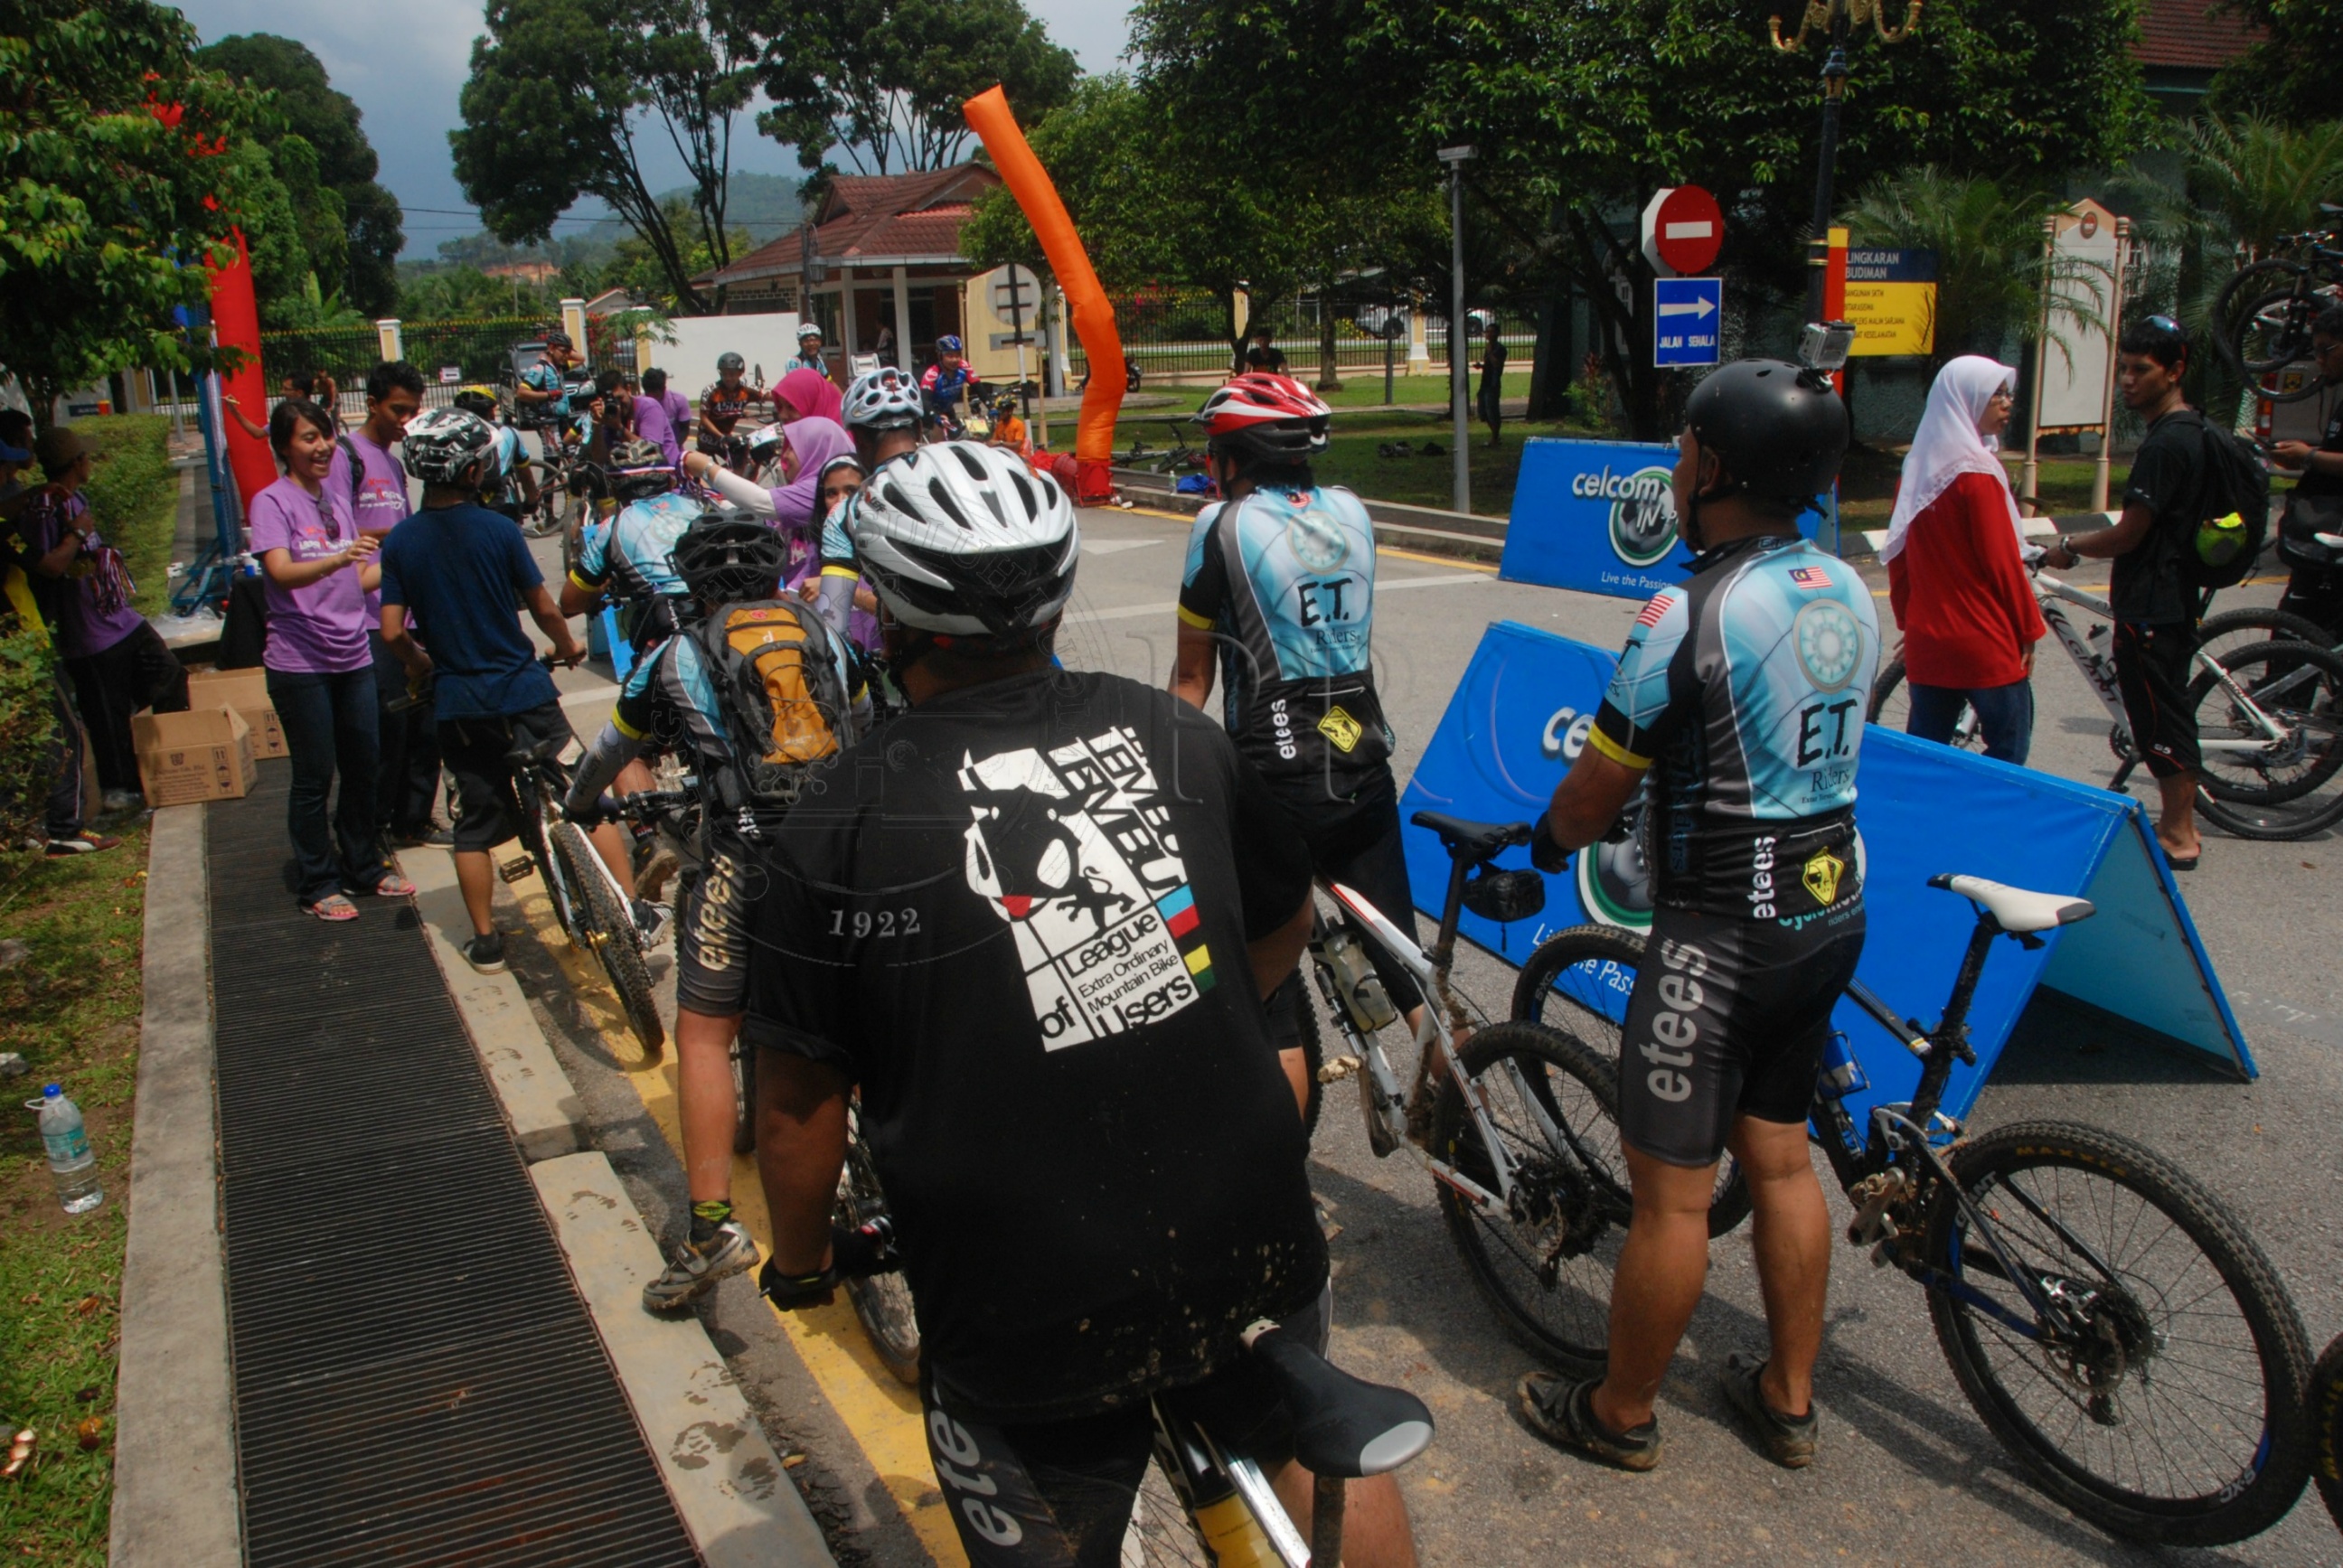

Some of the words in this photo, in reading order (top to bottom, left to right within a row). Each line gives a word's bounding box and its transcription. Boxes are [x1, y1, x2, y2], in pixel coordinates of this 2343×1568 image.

[1845, 252, 1899, 265] LINGKARAN
[1845, 268, 1887, 278] BUDIMAN
[1659, 335, 1683, 349] JALAN
[1688, 334, 1716, 347] SEHALA
[1571, 465, 1661, 501] celcom
[1601, 570, 1620, 584] Live
[1622, 573, 1637, 587] the
[1639, 576, 1672, 589] Passion
[1271, 699, 1297, 759] etees
[1746, 835, 1777, 919] etees
[1060, 913, 1159, 979] League
[1077, 972, 1115, 999] Extra
[1113, 939, 1170, 977] Ordinary
[1039, 994, 1077, 1039] of
[1095, 974, 1192, 1037] Users
[1087, 971, 1151, 1014] Mountain
[1148, 954, 1179, 978] Bike
[1639, 938, 1708, 1103] etees
[2016, 1146, 2128, 1177] MAXXIS
[1954, 1170, 1998, 1229] GANT
[930, 1392, 1023, 1547] ete
